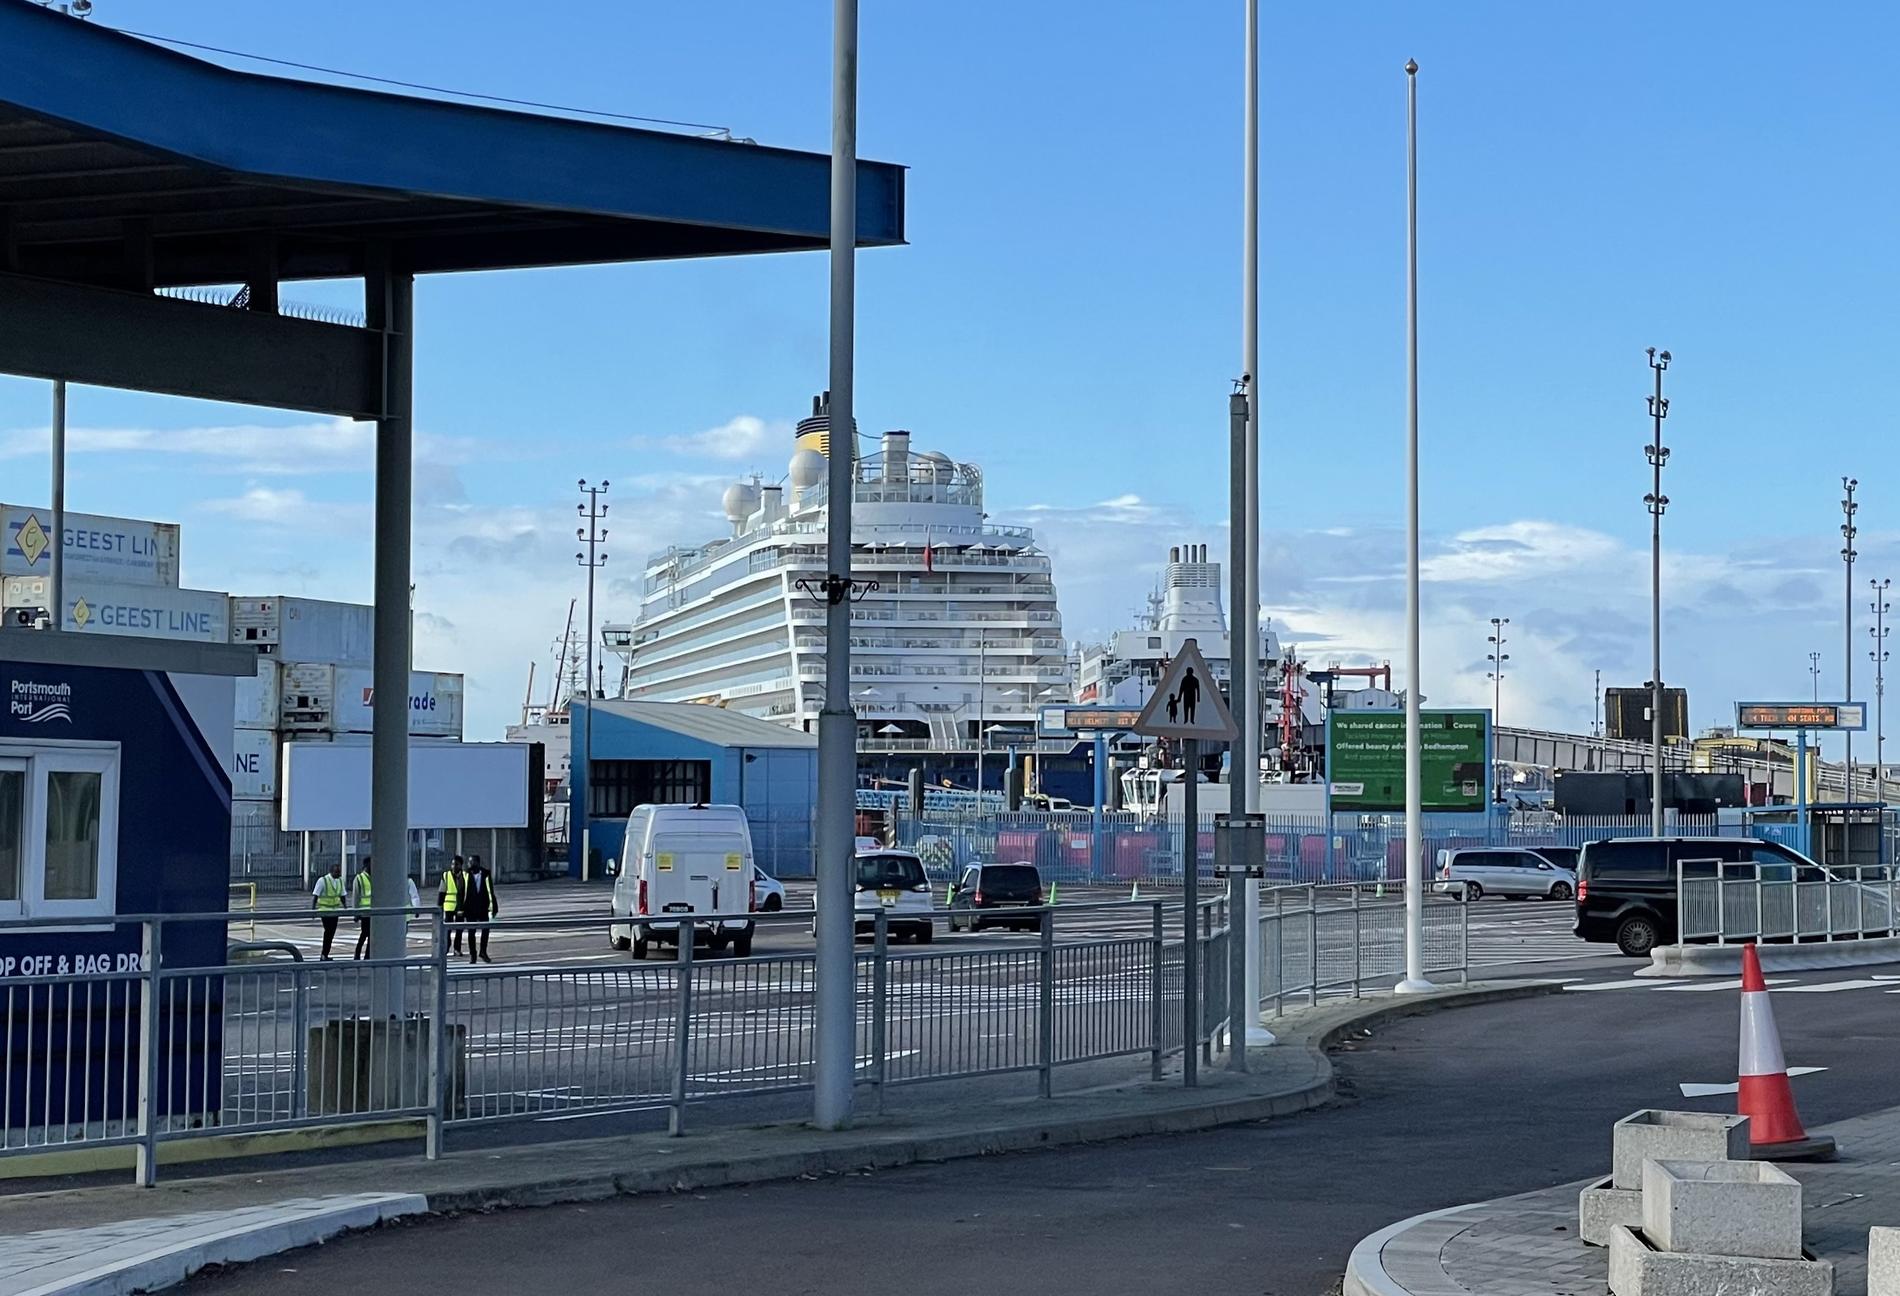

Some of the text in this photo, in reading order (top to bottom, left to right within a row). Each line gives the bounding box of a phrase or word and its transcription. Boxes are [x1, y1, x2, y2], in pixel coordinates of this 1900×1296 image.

[63, 528, 126, 553] GEEST
[100, 605, 165, 630] GEEST
[169, 610, 211, 633] LINE
[11, 680, 71, 696] Portsmouth
[11, 693, 71, 703] INTERNATIONAL
[11, 700, 32, 715] Port
[1349, 721, 1374, 729] shared
[1336, 742, 1364, 750] Offered
[1365, 742, 1390, 751] beauty
[20, 955, 53, 976] OFF
[57, 954, 70, 974] &
[75, 953, 111, 974] BAG
